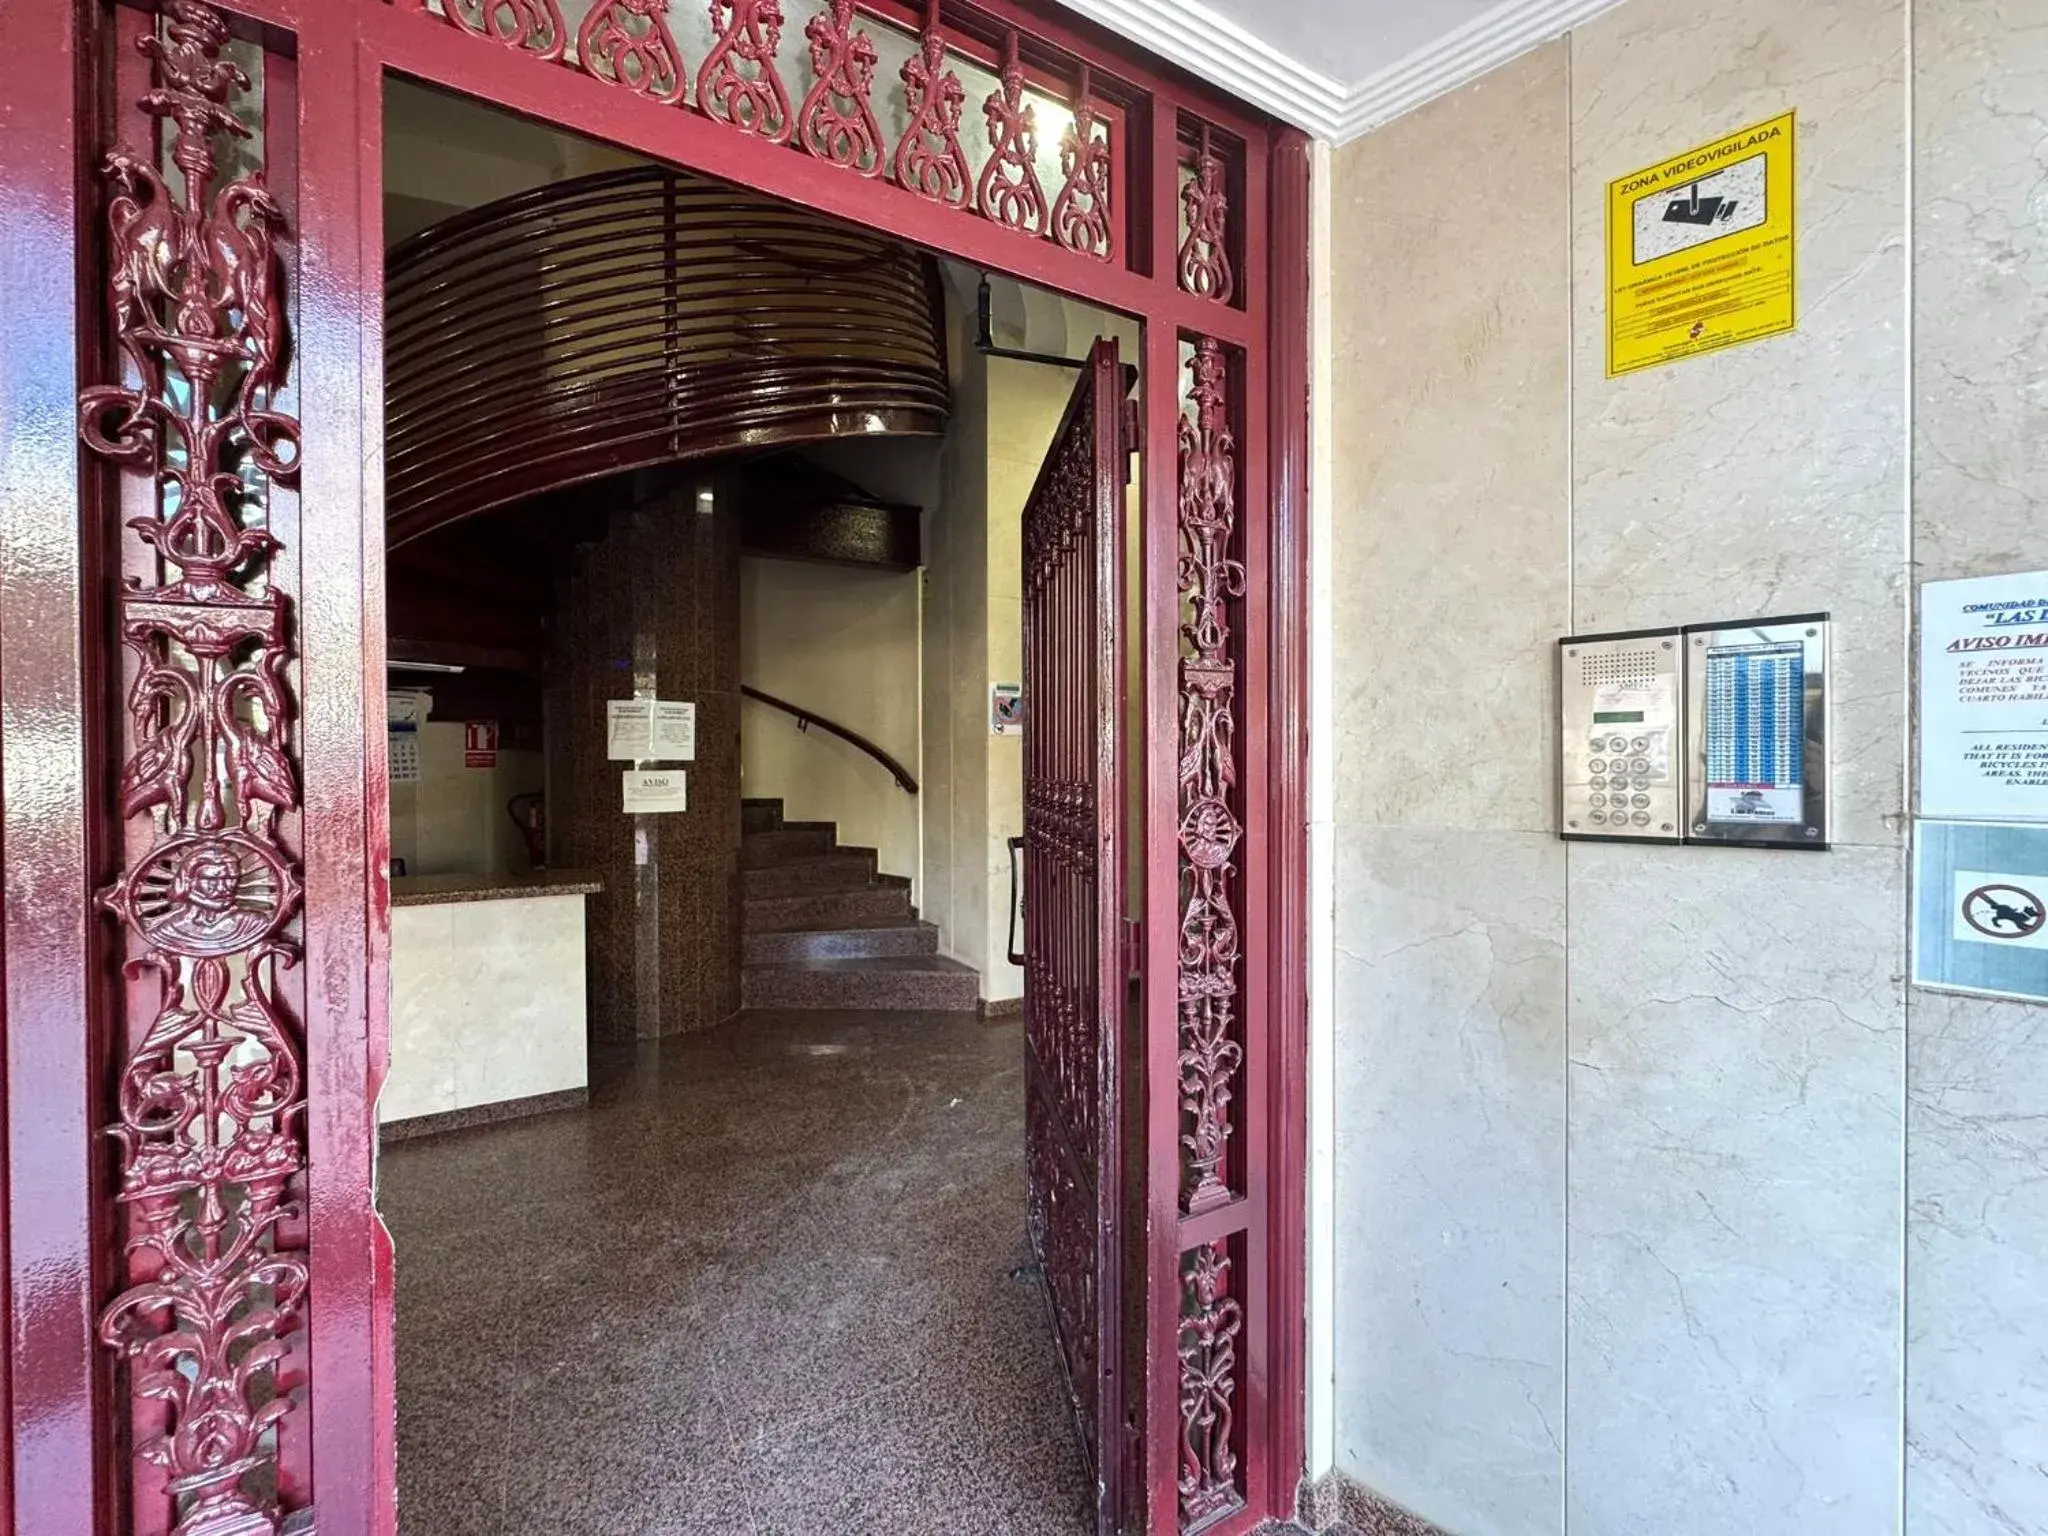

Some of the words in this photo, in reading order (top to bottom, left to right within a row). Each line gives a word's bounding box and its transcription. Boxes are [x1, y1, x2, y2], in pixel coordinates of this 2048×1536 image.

[1620, 173, 1660, 196] ZONA
[1663, 126, 1781, 178] VIDEOVIGILADA
[1962, 599, 2036, 612] COMUNIDAD
[1945, 636, 2012, 650] AVISO
[1987, 657, 2044, 667] INFORMA
[1960, 668, 2011, 677] VECINOS
[2018, 666, 2045, 675] QUE
[1959, 677, 1997, 686] DEJAR
[1999, 676, 2022, 684] LAS
[1959, 685, 2018, 694] COMUNES
[1959, 694, 2006, 703] CUARTO
[1970, 744, 1993, 752] ALL
[1995, 752, 2009, 760] IT
[2010, 752, 2022, 760] IS
[1980, 761, 2038, 769] BICYCLES
